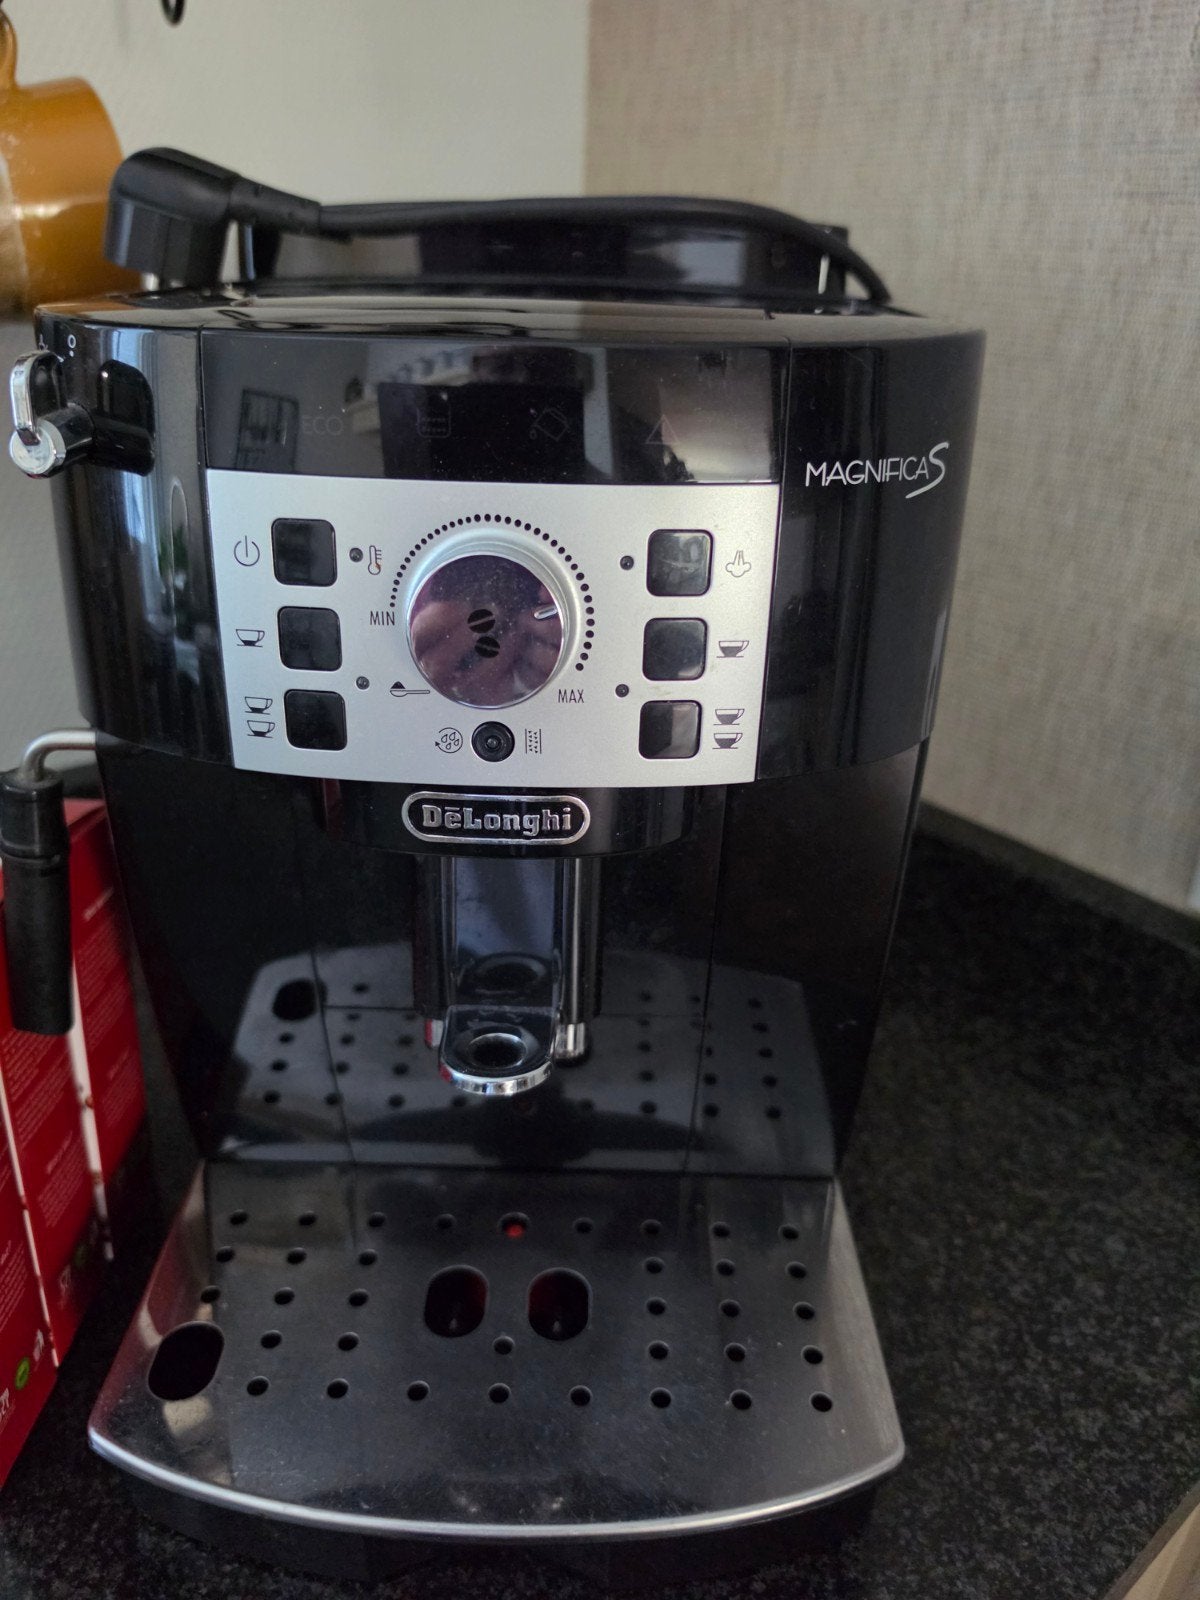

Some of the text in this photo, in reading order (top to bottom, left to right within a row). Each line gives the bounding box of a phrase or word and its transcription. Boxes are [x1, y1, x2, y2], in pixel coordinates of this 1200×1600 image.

[301, 416, 344, 436] ECO
[370, 610, 395, 626] MIN
[558, 688, 584, 704] MAX
